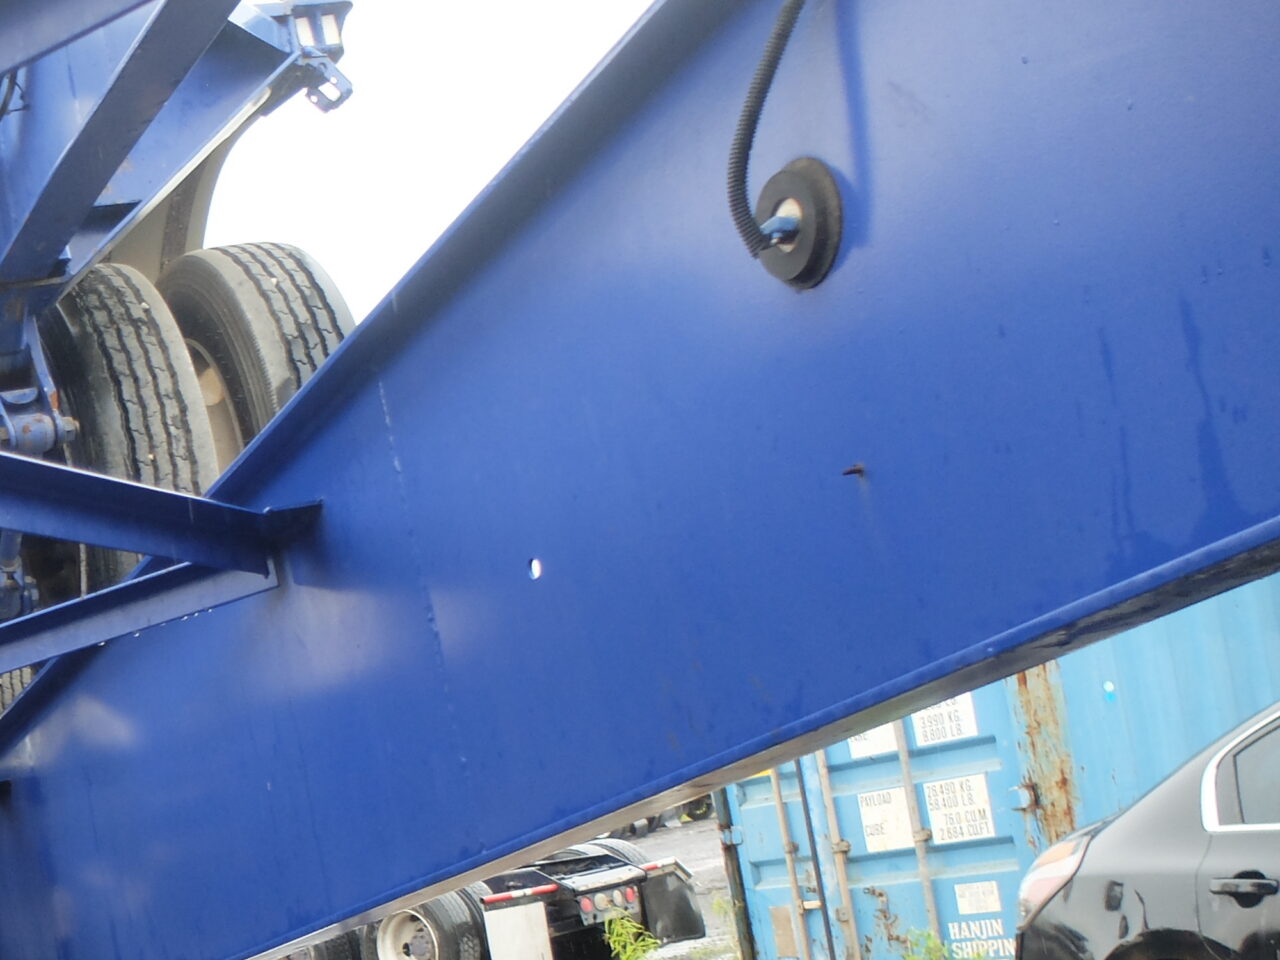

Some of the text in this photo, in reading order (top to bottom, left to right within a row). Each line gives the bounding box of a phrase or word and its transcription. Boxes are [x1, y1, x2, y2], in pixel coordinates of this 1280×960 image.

[860, 791, 892, 808] PAYLOAD
[865, 822, 887, 837] CUBE
[948, 918, 1004, 940] HANJIN
[951, 938, 1017, 959] SHIPPIN
